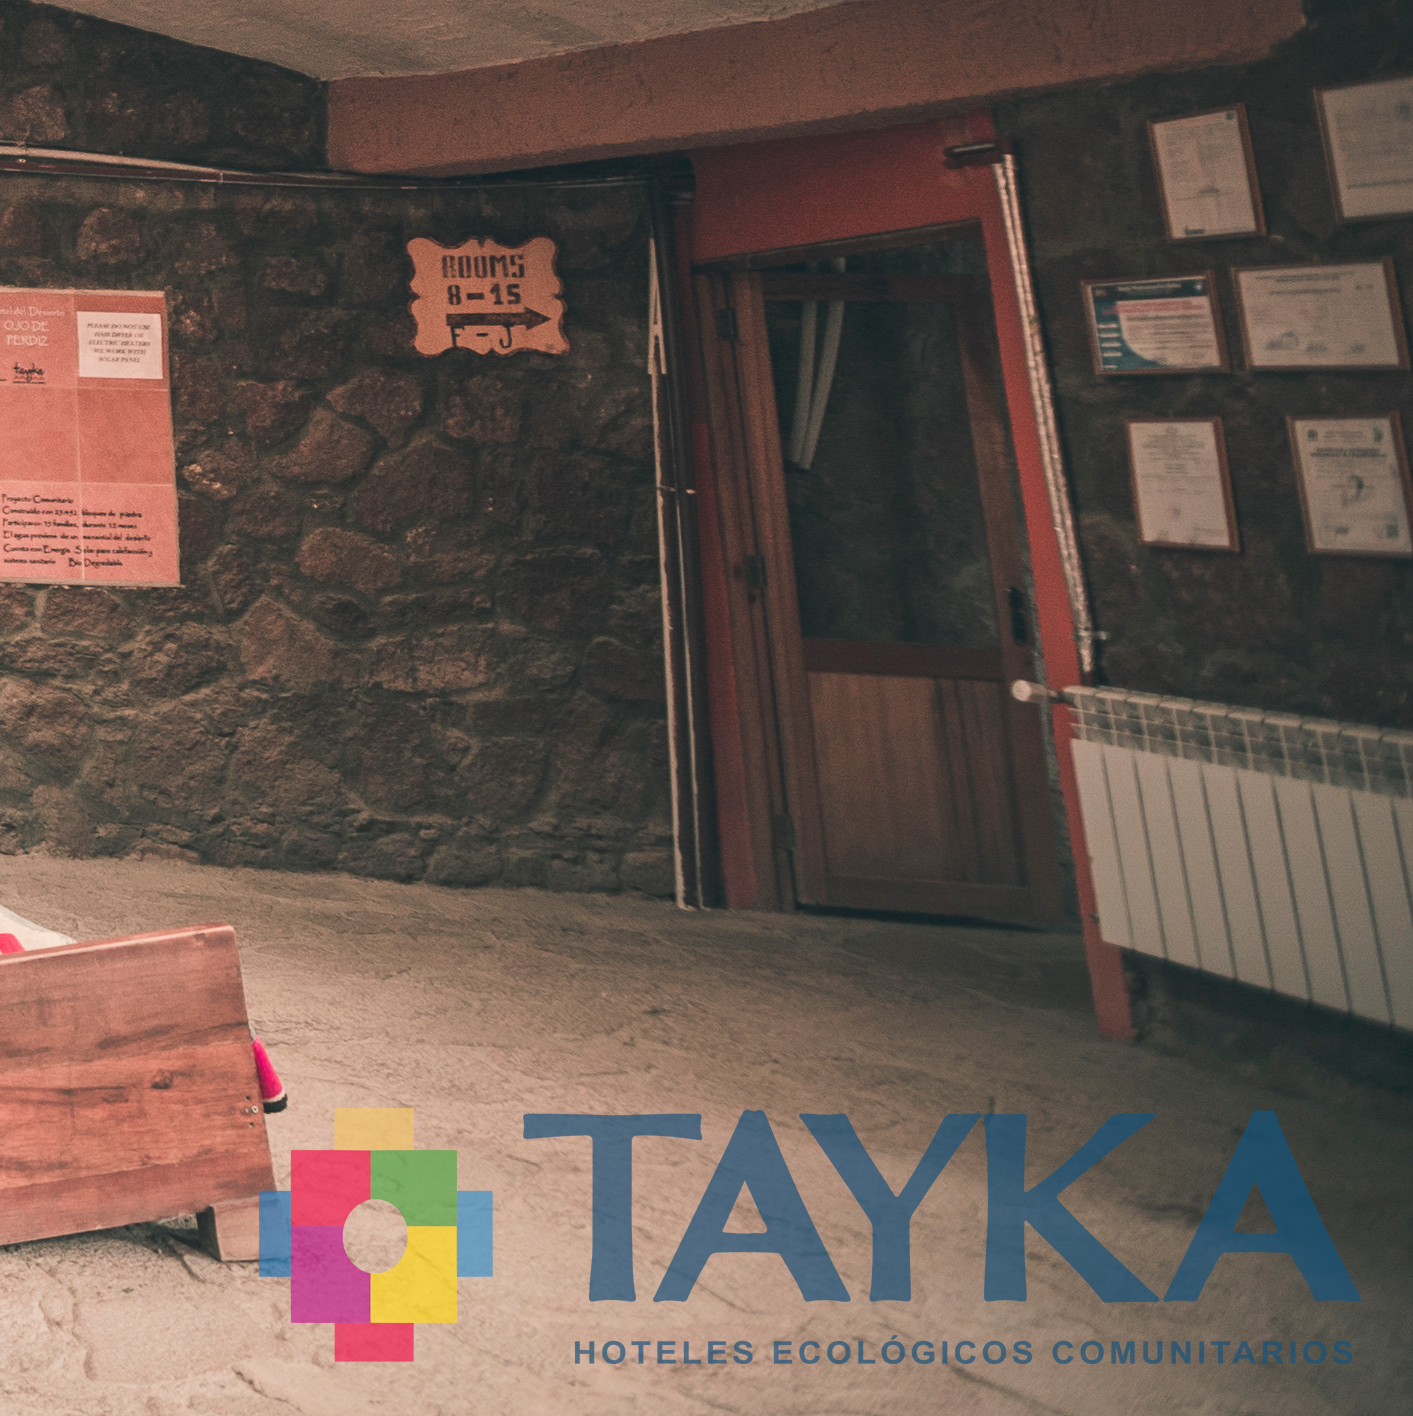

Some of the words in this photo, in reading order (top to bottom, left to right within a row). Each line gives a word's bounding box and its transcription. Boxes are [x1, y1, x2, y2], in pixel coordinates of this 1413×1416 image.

[442, 254, 525, 279] ROOMS
[4, 320, 30, 331] OJO
[31, 320, 51, 332] DE
[6, 334, 49, 347] PERDIZ
